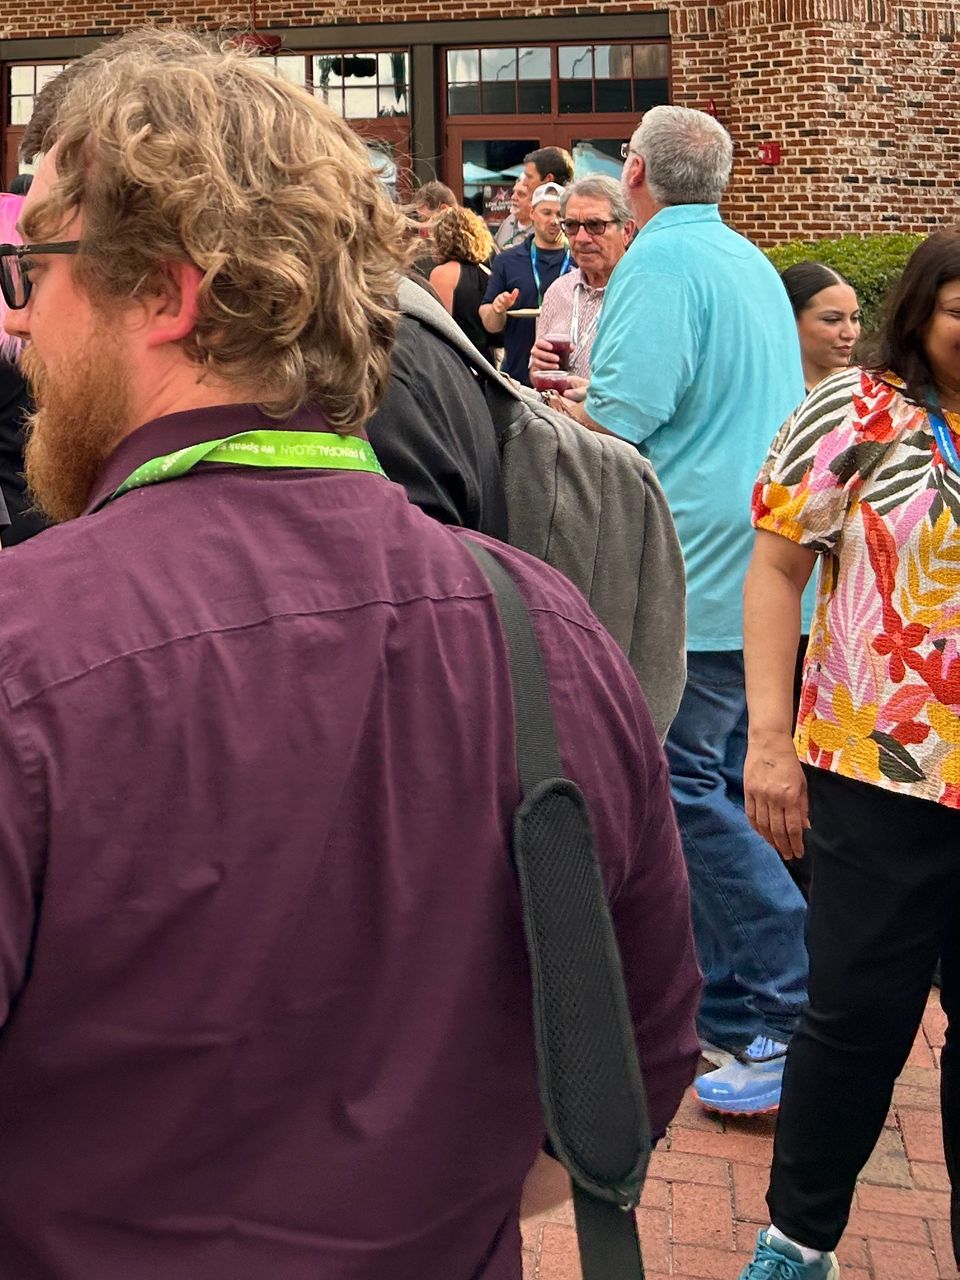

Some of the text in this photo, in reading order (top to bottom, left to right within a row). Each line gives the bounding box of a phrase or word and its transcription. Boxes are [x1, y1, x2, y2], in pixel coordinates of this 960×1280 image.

[228, 442, 260, 454] Speak
[260, 445, 276, 454] We
[280, 444, 317, 456] SLOAN
[319, 445, 359, 458] PRINCIPAL
